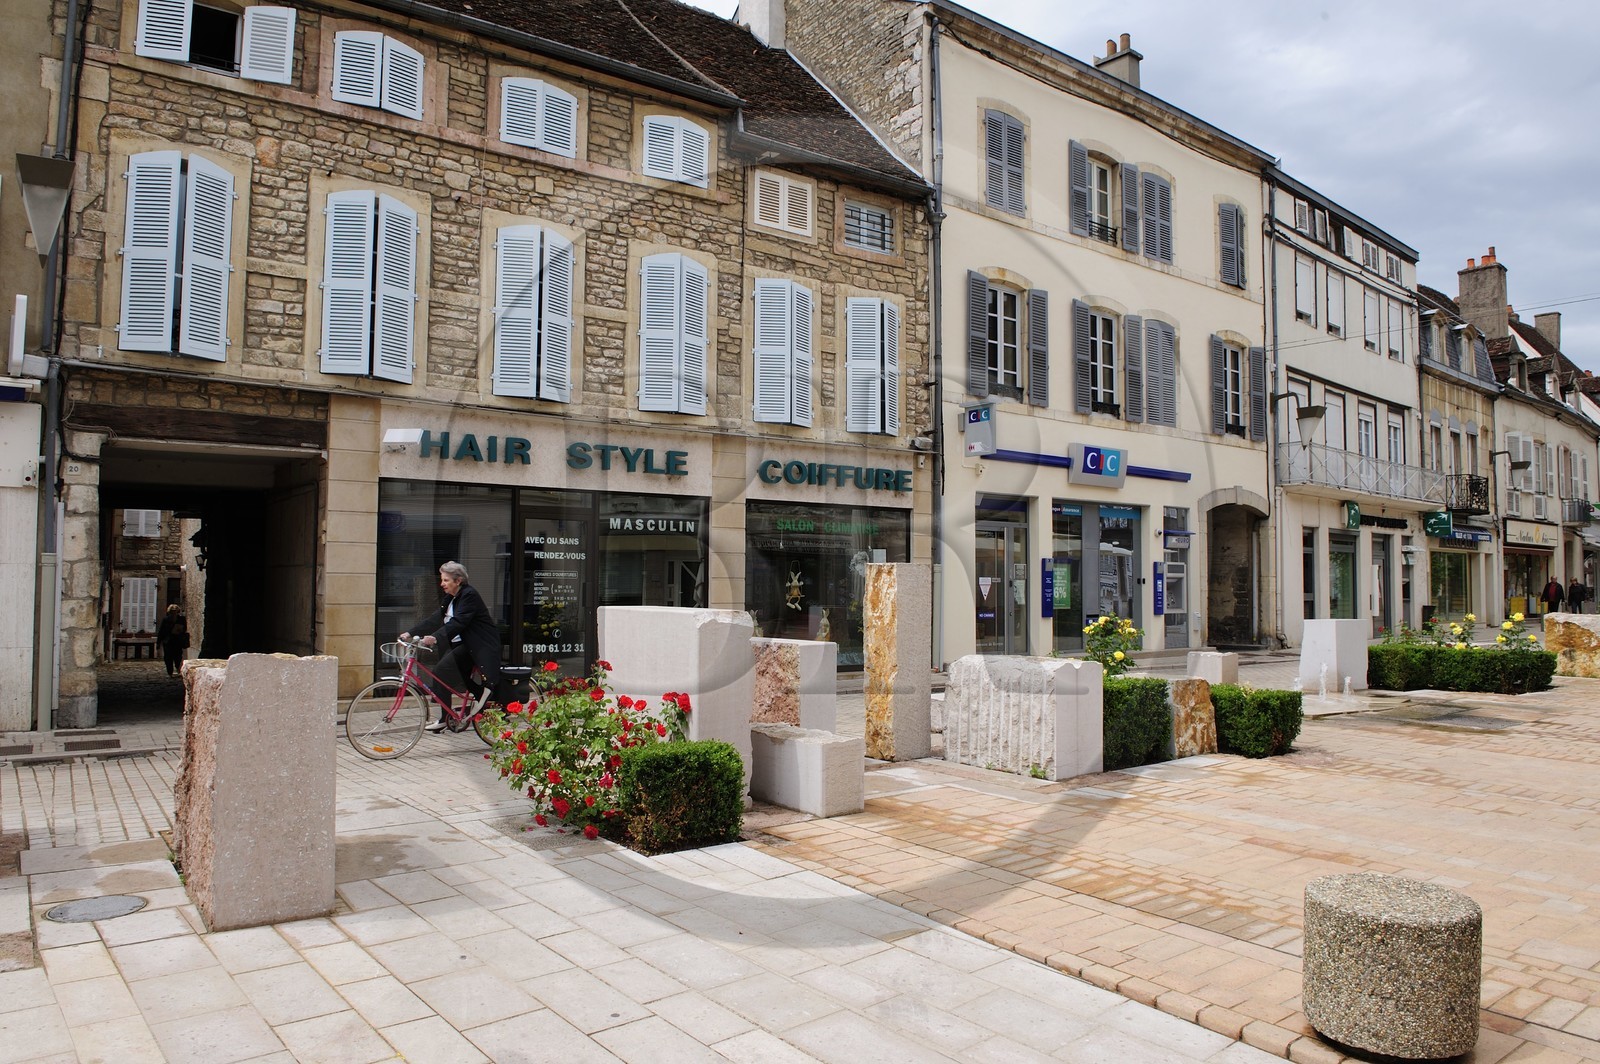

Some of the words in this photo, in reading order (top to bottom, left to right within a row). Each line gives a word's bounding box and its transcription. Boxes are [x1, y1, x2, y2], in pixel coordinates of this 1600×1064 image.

[419, 430, 532, 465] HAIR
[566, 442, 689, 475] STYLE
[1086, 451, 1117, 472] CIC
[758, 459, 913, 492] COIFFURE
[609, 517, 695, 533] MASCULIN
[776, 518, 814, 532] SALON
[525, 536, 545, 544] AVEC
[546, 537, 558, 545] OU
[534, 551, 586, 560] RENDEZ-VOUS
[1053, 586, 1067, 599] 6%
[522, 644, 534, 653] 03
[535, 643, 547, 653] 80
[548, 643, 559, 653] 61
[561, 643, 572, 653] 12
[574, 643, 585, 652] 31
